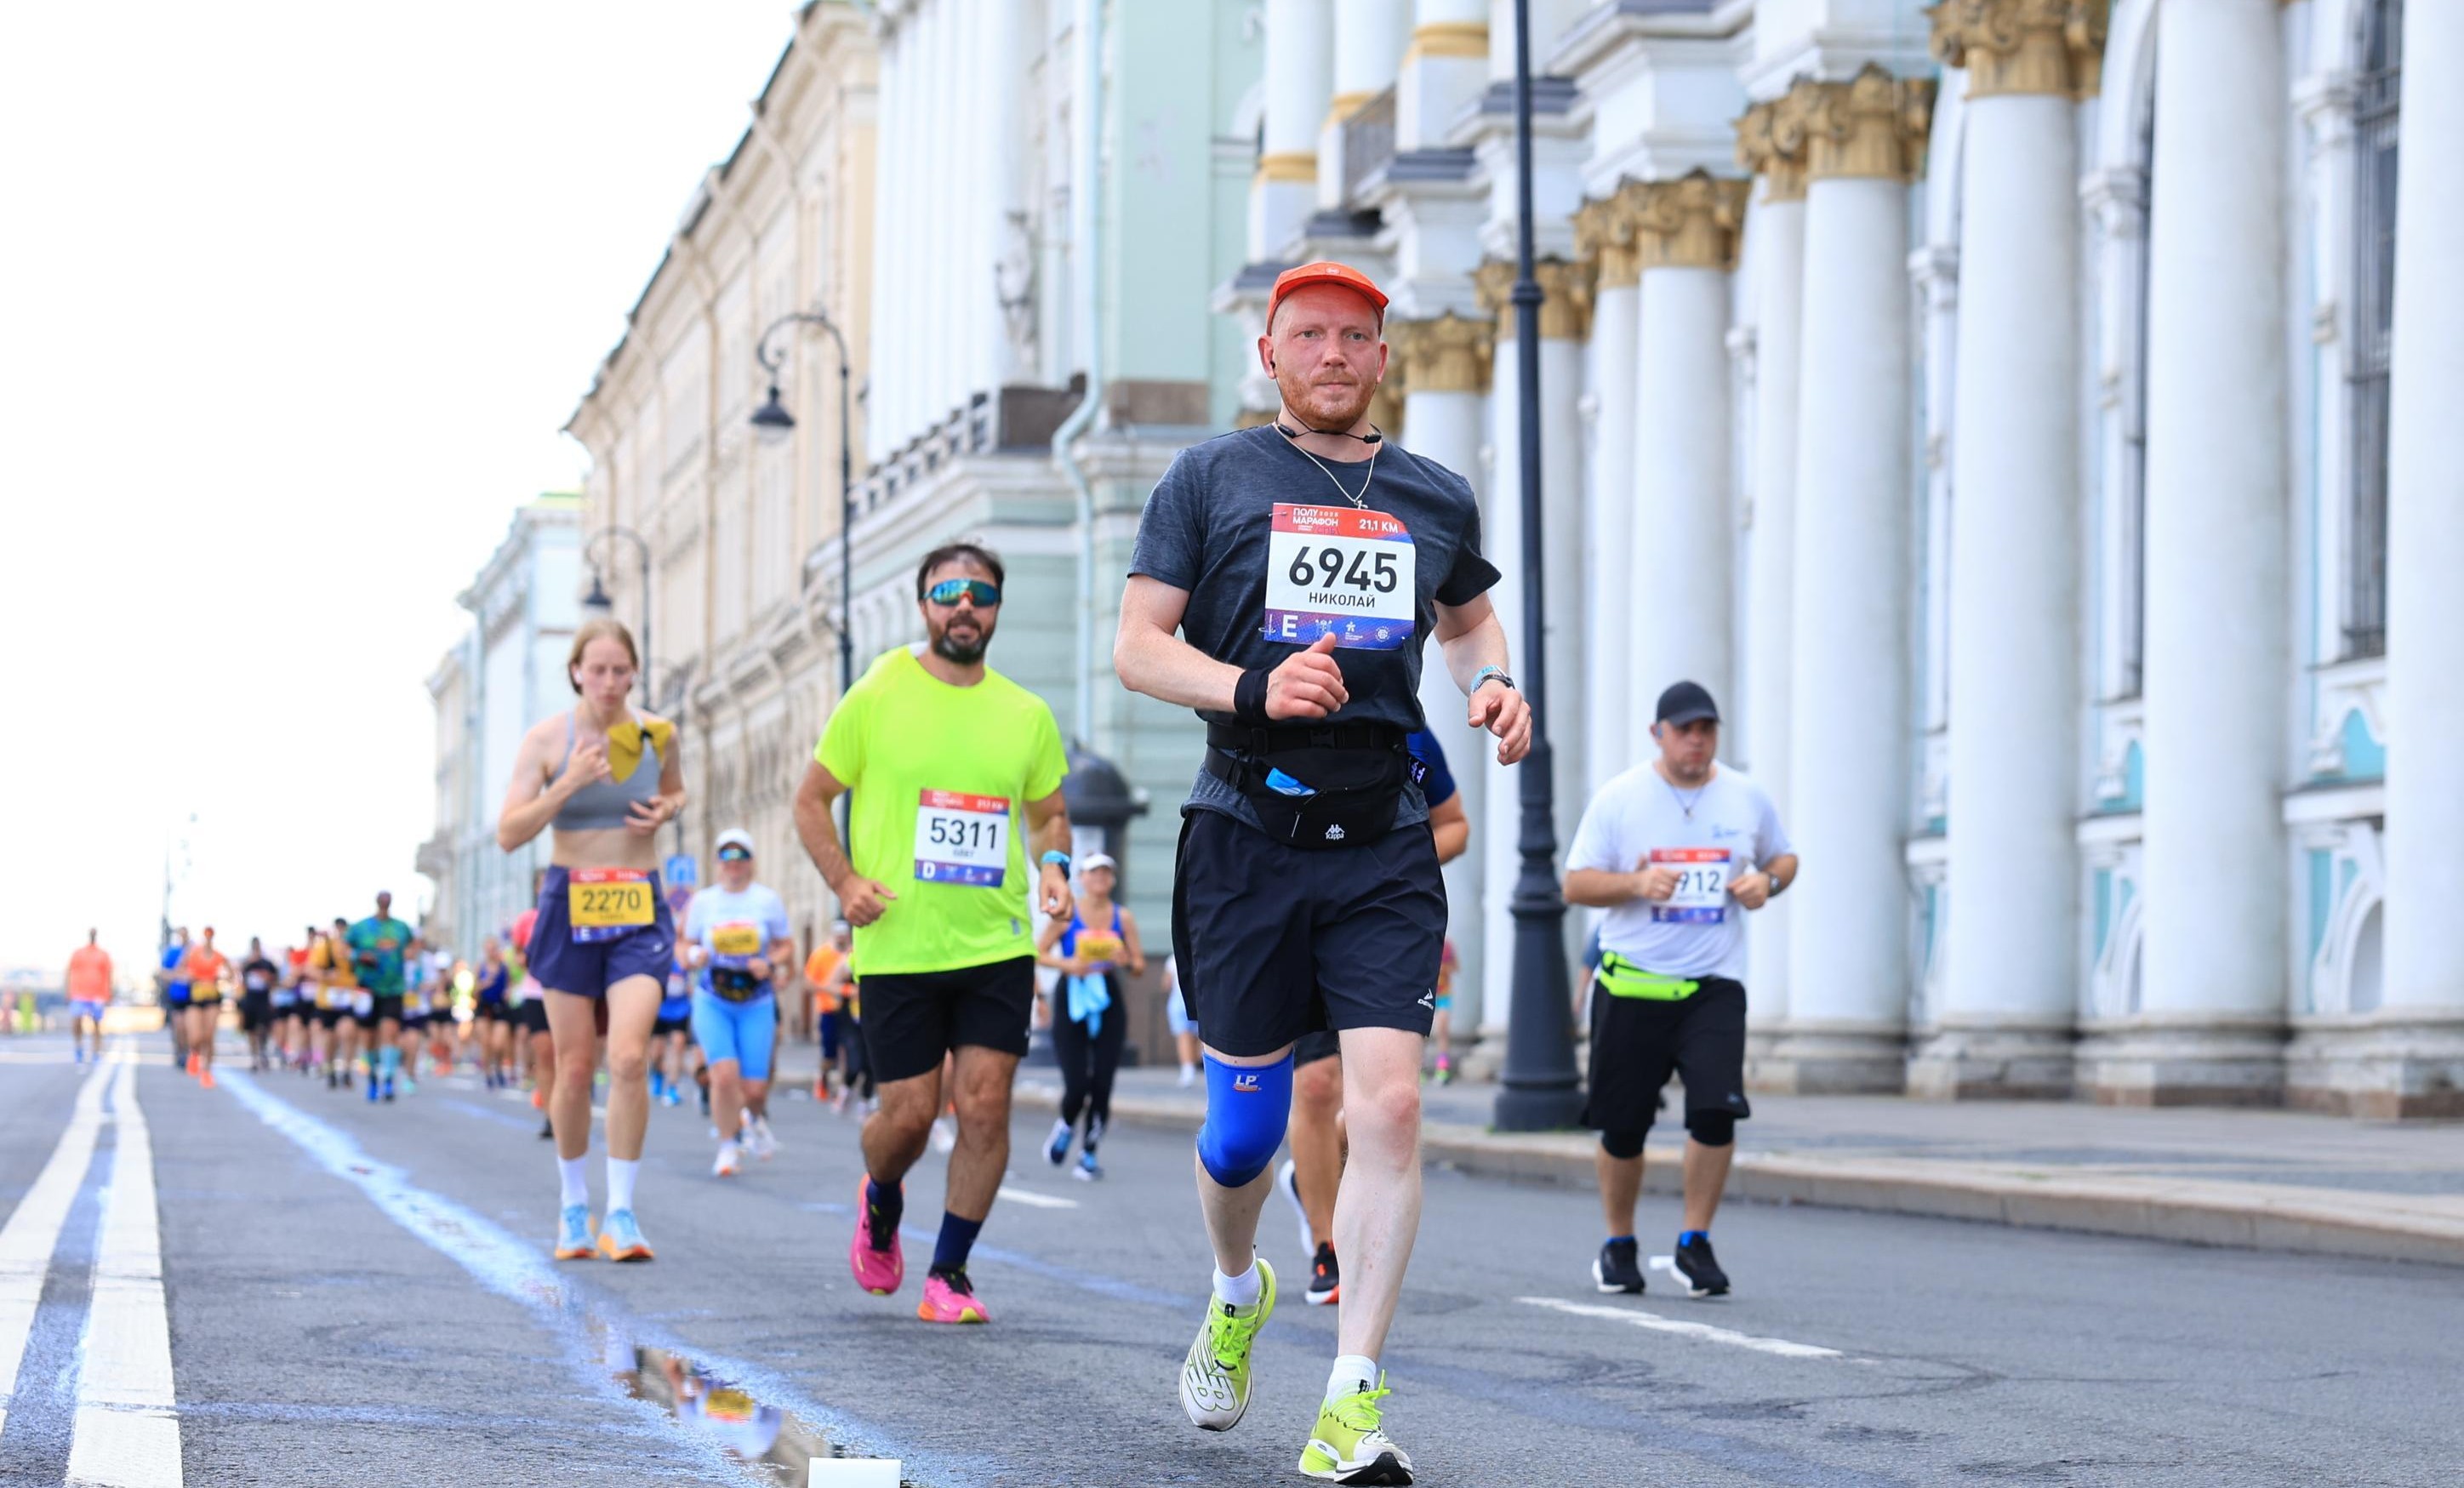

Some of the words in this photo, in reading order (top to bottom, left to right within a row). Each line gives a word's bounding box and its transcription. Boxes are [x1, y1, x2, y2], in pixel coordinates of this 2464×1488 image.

[1292, 516, 1339, 527] МАРАФОН
[1293, 508, 1319, 517] ПОЛУ
[1359, 519, 1378, 532] 21,1
[1289, 546, 1397, 593] 6945
[1309, 592, 1375, 608] НИКОЛАЙ
[1281, 614, 1298, 638] E
[930, 818, 996, 850] 5311
[922, 861, 936, 880] D
[1678, 870, 1720, 892] 912
[582, 889, 642, 913] 2270
[1235, 1075, 1258, 1086] LP
